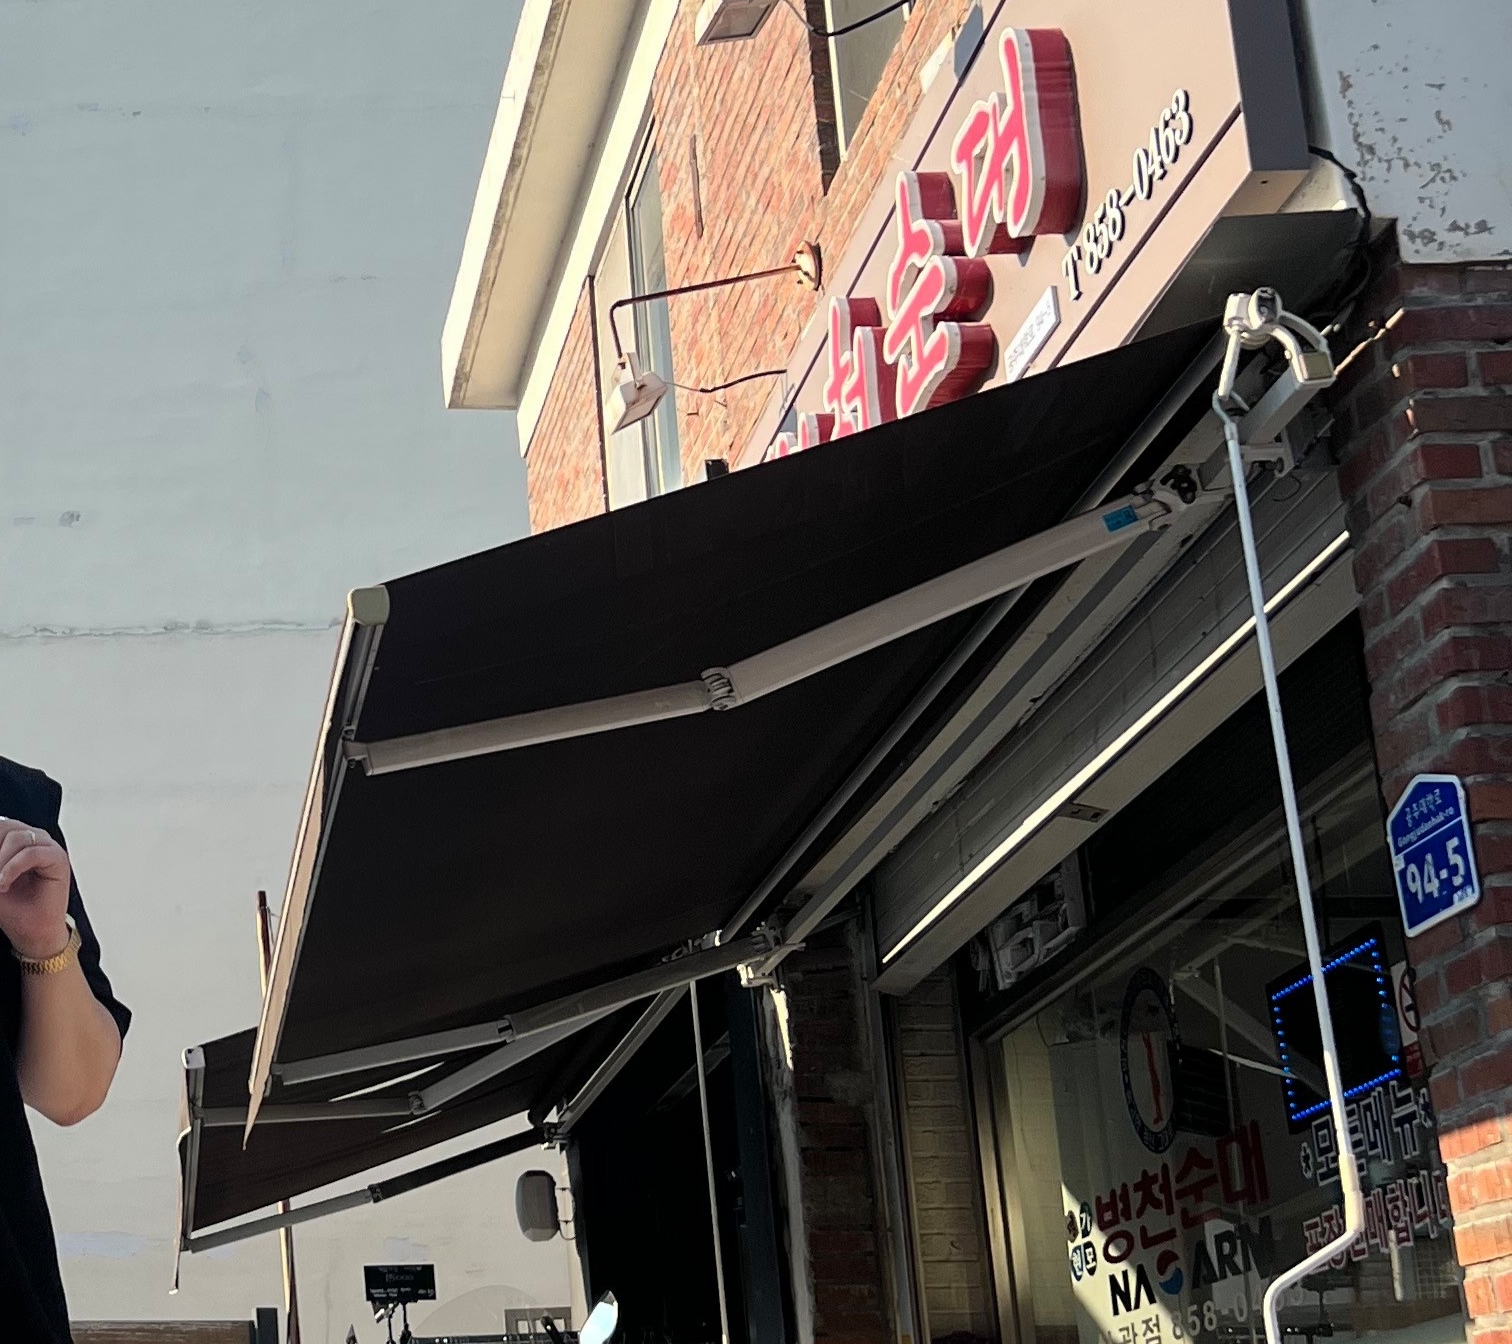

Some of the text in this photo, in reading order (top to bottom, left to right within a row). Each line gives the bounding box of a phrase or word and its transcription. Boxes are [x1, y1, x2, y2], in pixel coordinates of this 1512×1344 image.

[767, 27, 1063, 462] 천순대
[1084, 88, 1192, 275] 858-0463
[1406, 836, 1466, 904] 94-5
[1094, 1118, 1271, 1265] 병천순대
